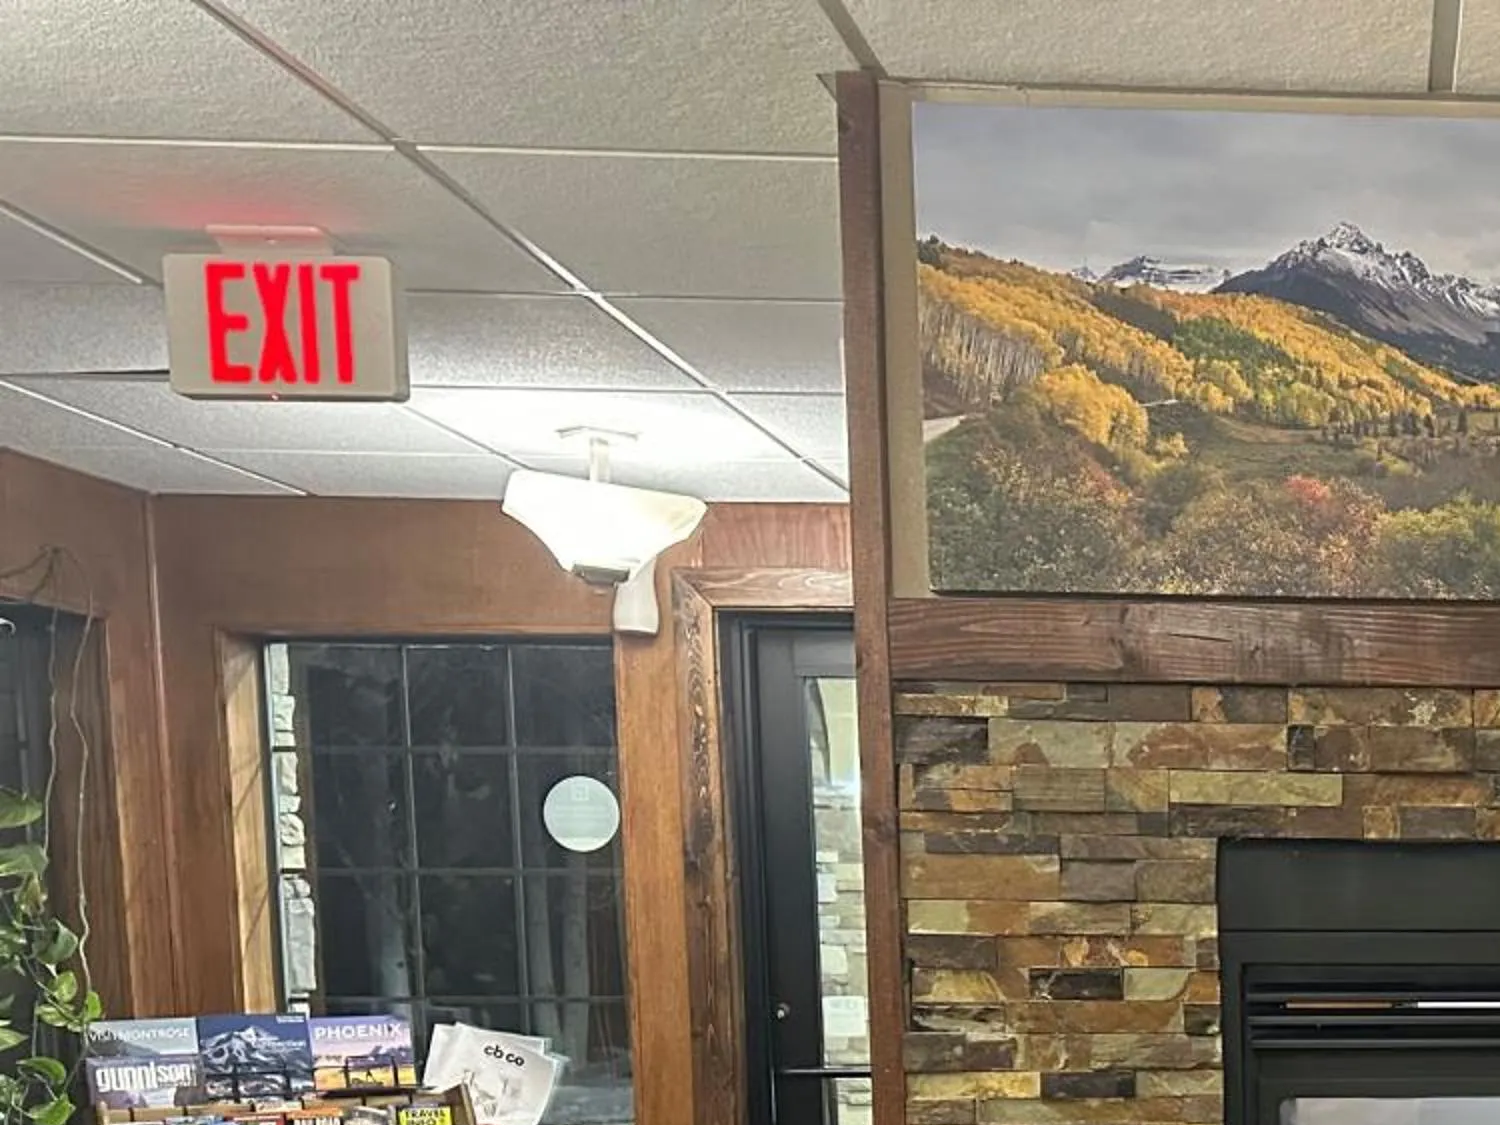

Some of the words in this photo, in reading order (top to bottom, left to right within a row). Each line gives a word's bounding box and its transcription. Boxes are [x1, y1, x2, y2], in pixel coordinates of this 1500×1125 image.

[205, 262, 360, 384] EXIT
[118, 1026, 191, 1043] MONTROSE
[314, 1023, 401, 1041] PHOENIX
[483, 1044, 504, 1059] cb
[505, 1052, 525, 1067] co
[95, 1060, 193, 1093] gunnison
[405, 1108, 446, 1119] TRAVEL
